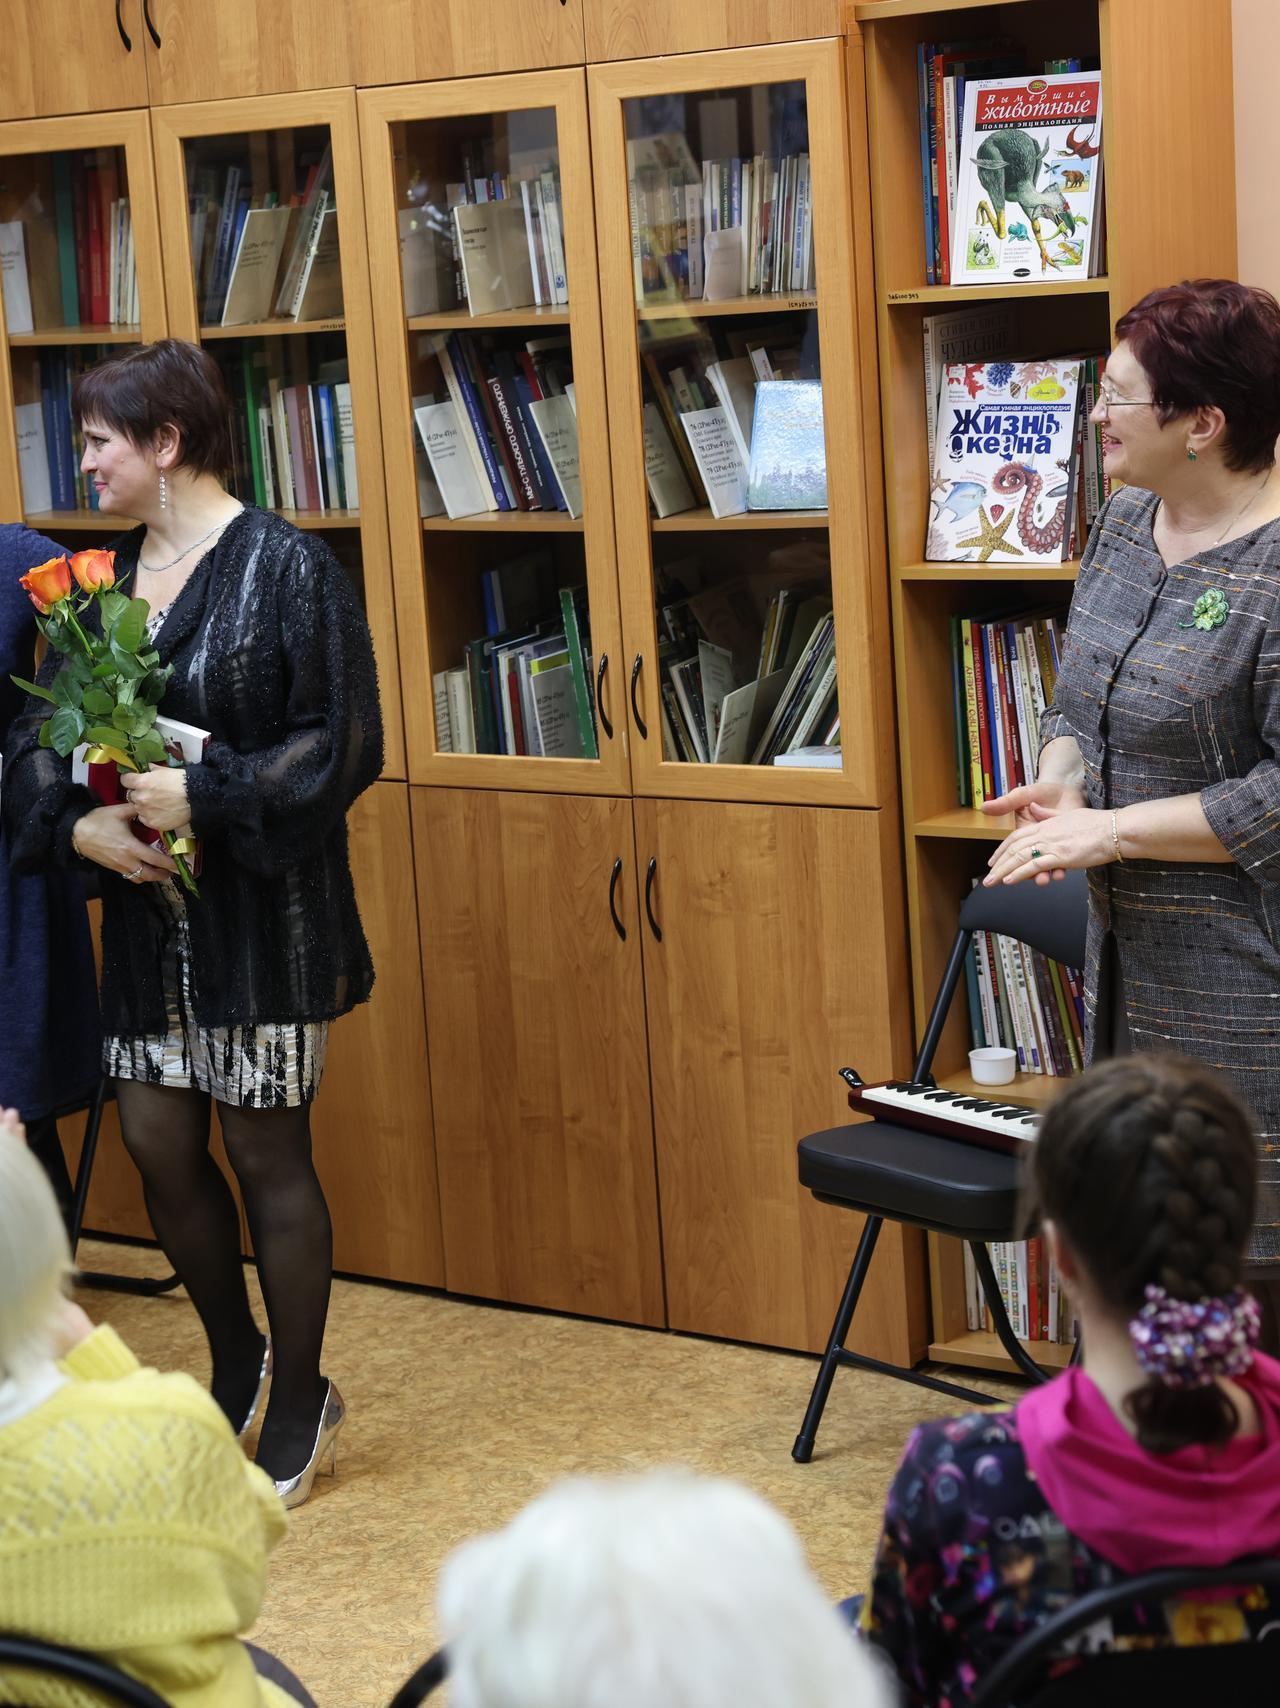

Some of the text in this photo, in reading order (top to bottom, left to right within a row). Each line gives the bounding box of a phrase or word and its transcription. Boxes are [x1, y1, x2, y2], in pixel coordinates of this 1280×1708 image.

[981, 99, 1092, 120] животные
[986, 89, 1086, 106] Вымершие
[489, 382, 517, 434] ОРУЖЕЙНОГО
[951, 408, 1062, 436] Жизнь
[506, 434, 529, 476] ТУЛЬСКОГО
